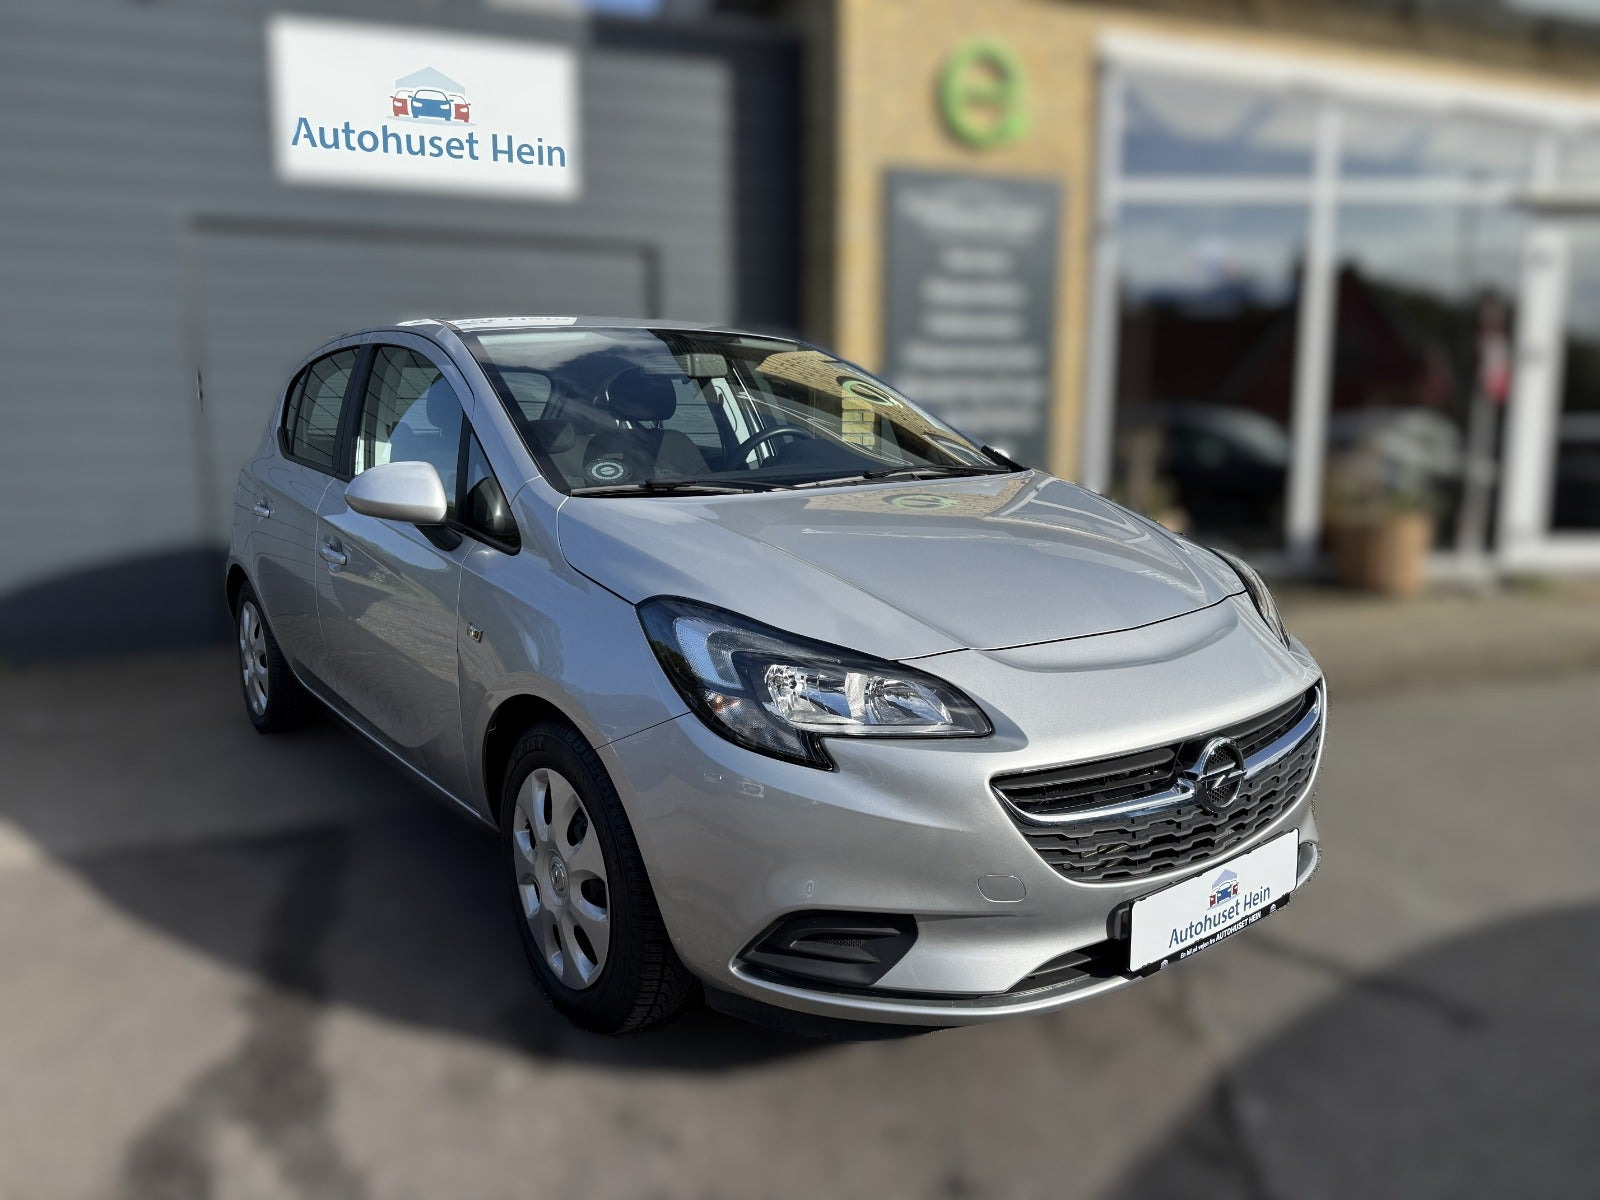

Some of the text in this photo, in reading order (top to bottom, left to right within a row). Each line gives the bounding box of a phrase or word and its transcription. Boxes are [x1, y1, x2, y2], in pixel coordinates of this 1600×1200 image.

[291, 117, 567, 167] Autohuset Hein
[1169, 886, 1270, 948] Autohuset Hein
[1215, 918, 1249, 942] AUTOHUSET
[1248, 910, 1262, 924] HEIN
